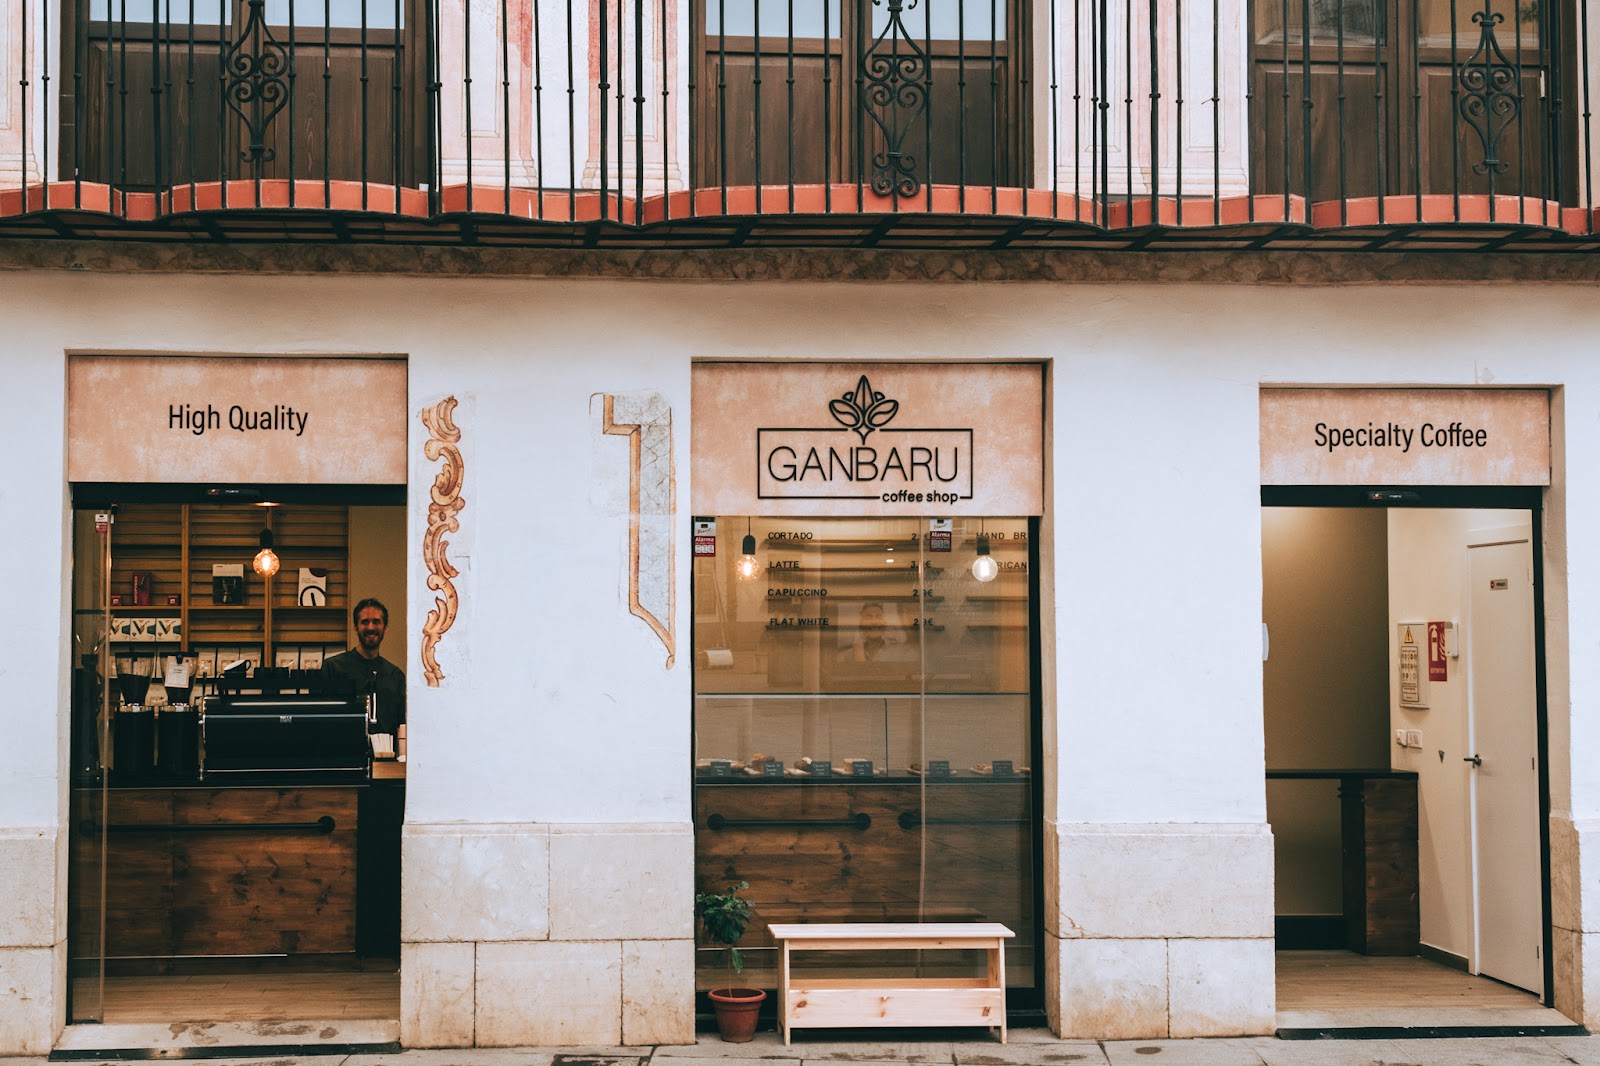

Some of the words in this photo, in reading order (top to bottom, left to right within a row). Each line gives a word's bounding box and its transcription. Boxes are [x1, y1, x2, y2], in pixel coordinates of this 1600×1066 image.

[168, 403, 220, 436] High
[228, 404, 309, 437] Quality
[1314, 421, 1414, 453] Specialty
[1420, 421, 1488, 447] Coffee
[767, 445, 958, 482] GANBARU
[882, 490, 924, 503] coffee
[926, 490, 959, 505] shop
[767, 532, 813, 540] CORTADO
[769, 561, 800, 569] LATTE
[767, 588, 828, 597] CAPUCCINO
[769, 618, 795, 626] FLAT
[797, 618, 829, 626] WHITE
